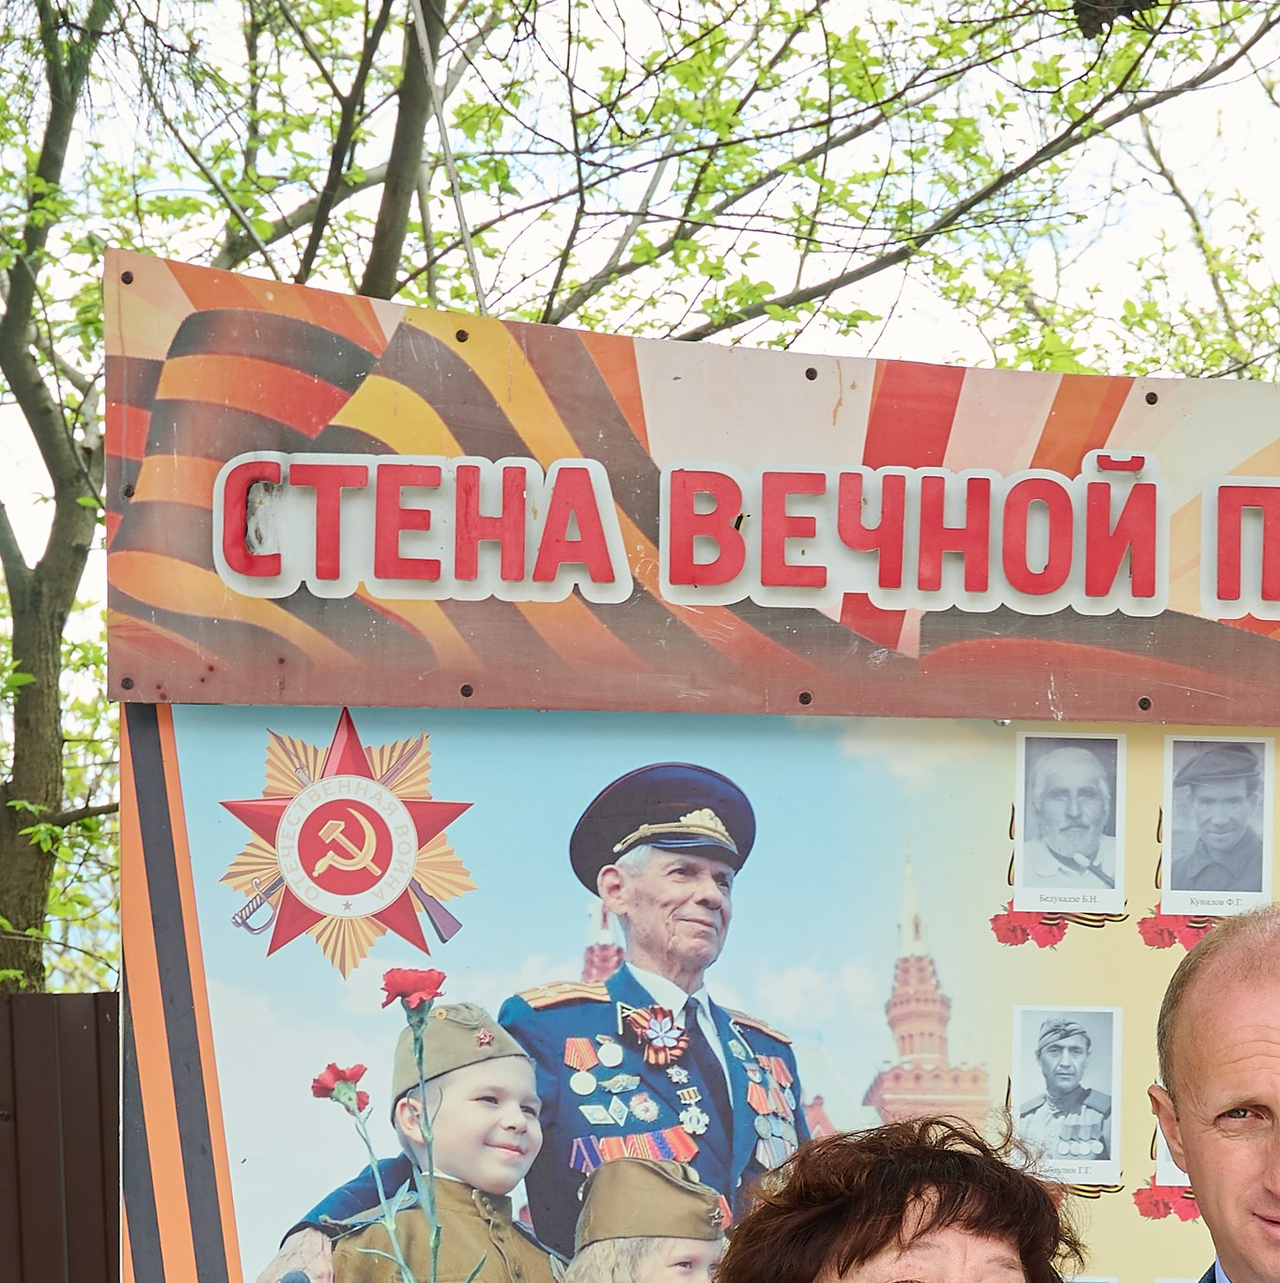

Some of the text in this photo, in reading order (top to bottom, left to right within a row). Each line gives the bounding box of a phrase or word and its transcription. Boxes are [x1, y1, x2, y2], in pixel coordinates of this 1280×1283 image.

[221, 460, 616, 584] СТЕНА
[668, 454, 1158, 598] ВЕЧНОЙ
[280, 779, 412, 902] ОТЕЧЕСТВЕННАЯ ВОЙНА
